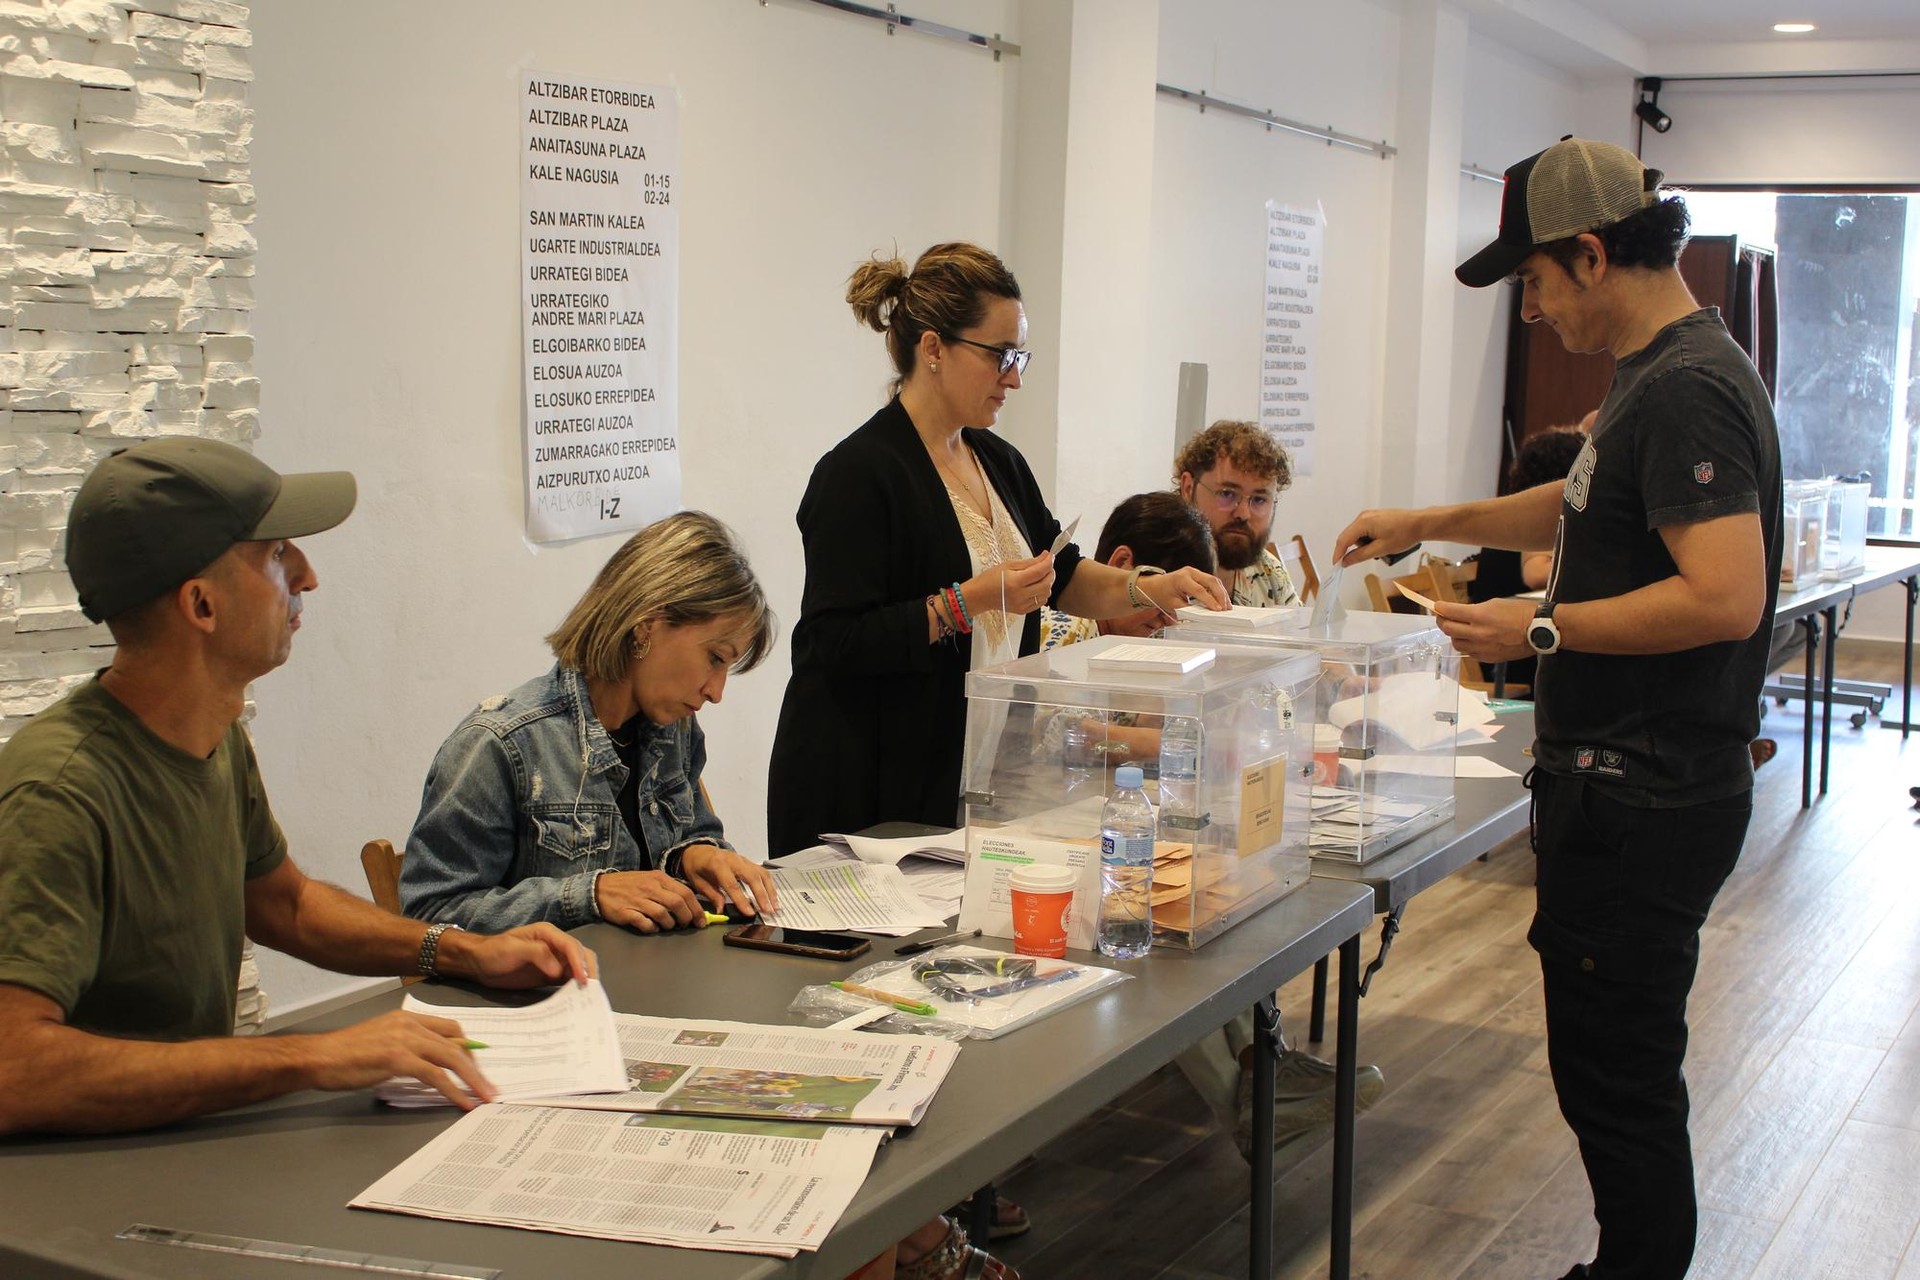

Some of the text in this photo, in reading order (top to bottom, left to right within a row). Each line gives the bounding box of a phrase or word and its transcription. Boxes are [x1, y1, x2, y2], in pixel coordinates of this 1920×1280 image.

[528, 81, 655, 109] ALTZIBAR ETORBIDEA
[529, 109, 628, 132] ALTZIBAR PLAZA
[530, 137, 646, 160] ANAITASUNA PLAZA
[530, 165, 670, 188] KALE NAGUSIA 01-15
[645, 191, 670, 205] 02-24
[530, 210, 645, 230] SAN MARTIN KALEA
[530, 238, 660, 256] UGARTE INDUSTRIALDEA
[530, 266, 628, 282] URRATEGI BIDEA
[531, 294, 609, 308] URRATEGIKO
[532, 311, 644, 326] ANDRE MARI PLAZA
[533, 338, 646, 353] ELGOIBARKO BIDEA
[534, 364, 622, 380] ELOSUA AUZOA
[535, 389, 655, 408] ELOSUKO ERREPIDEA
[536, 416, 633, 435] URRATEGI AUZOA
[536, 437, 676, 462] ZUMARRAGAKO ERREPIDEA
[537, 466, 650, 489] AIZPURUTXO AUZOA
[600, 498, 620, 520] I-Z
[1598, 766, 1623, 775] RAIDERS
